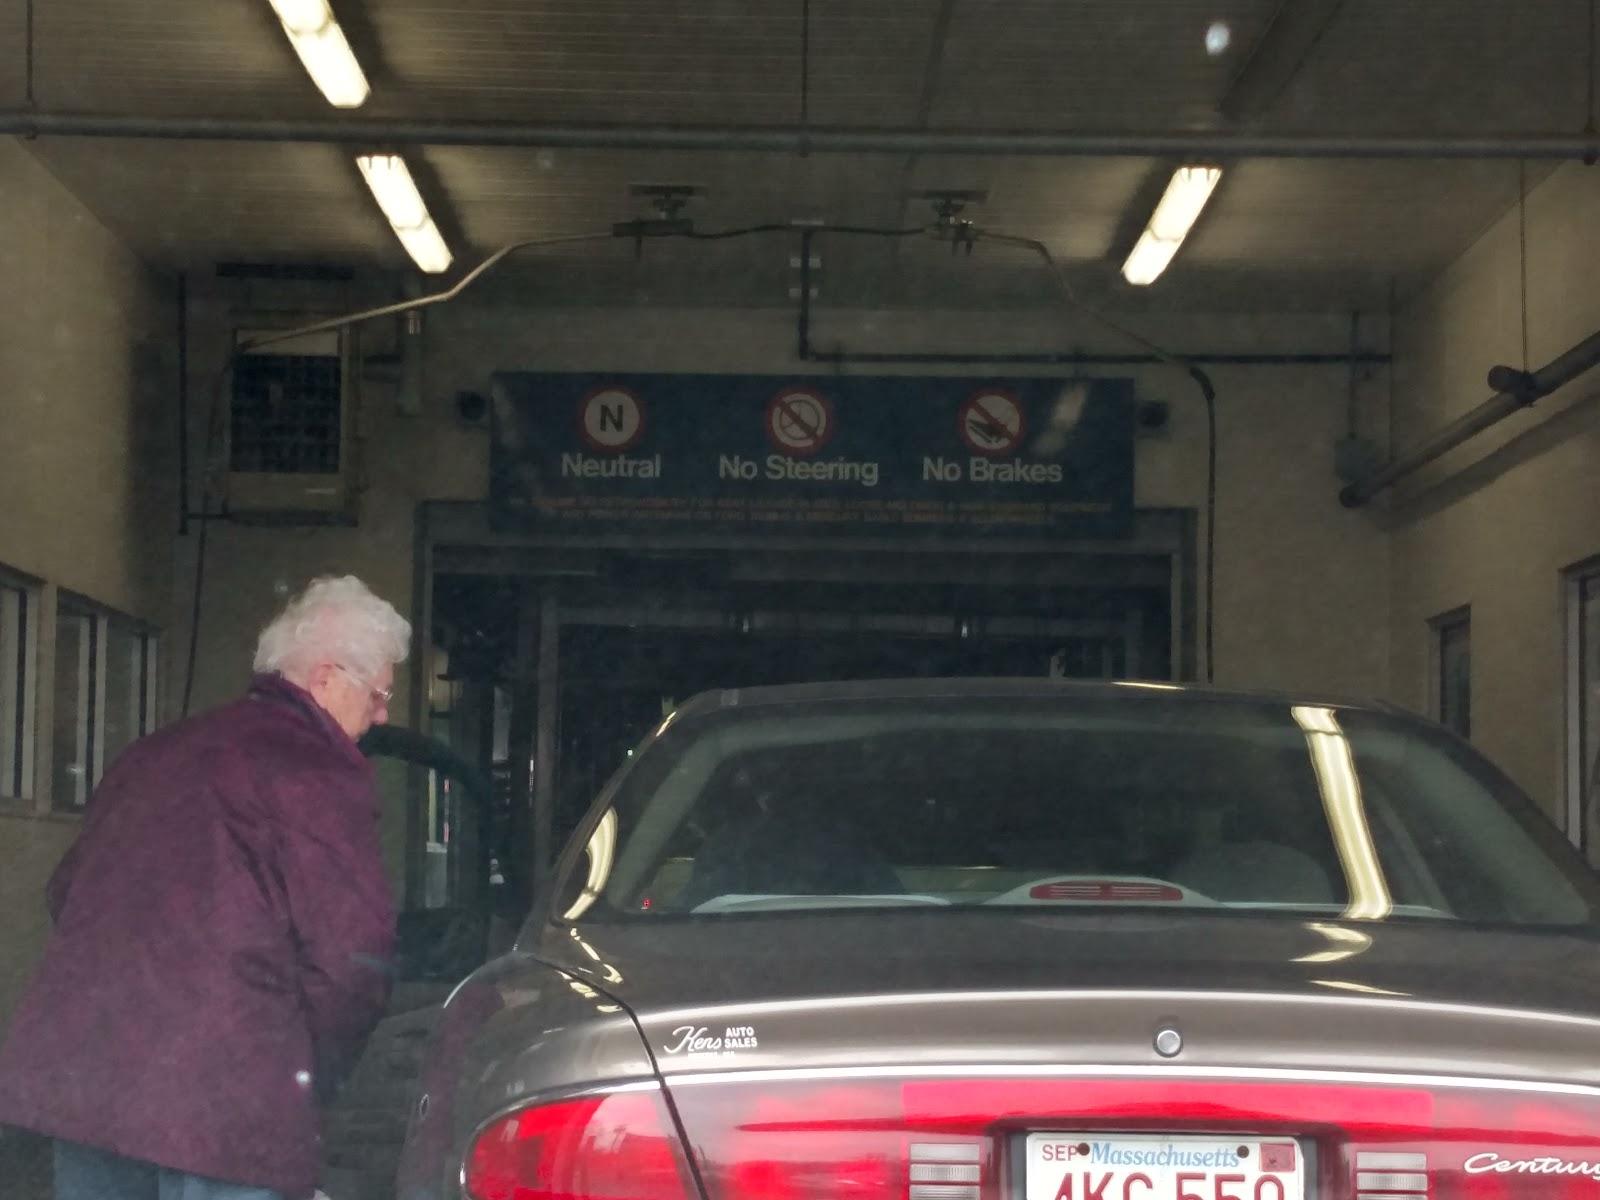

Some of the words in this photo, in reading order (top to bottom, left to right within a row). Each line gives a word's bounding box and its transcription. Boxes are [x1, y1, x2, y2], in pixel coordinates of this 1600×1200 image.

[600, 404, 624, 432] N
[561, 452, 662, 479] Neutral
[719, 455, 758, 480] No
[765, 455, 879, 487] Steering
[922, 456, 961, 482] No
[969, 456, 1063, 483] Brakes
[724, 1037, 758, 1049] SALES
[725, 1026, 755, 1038] AUTO
[1042, 1144, 1078, 1161] SEP
[1090, 1142, 1240, 1168] Massachusetts
